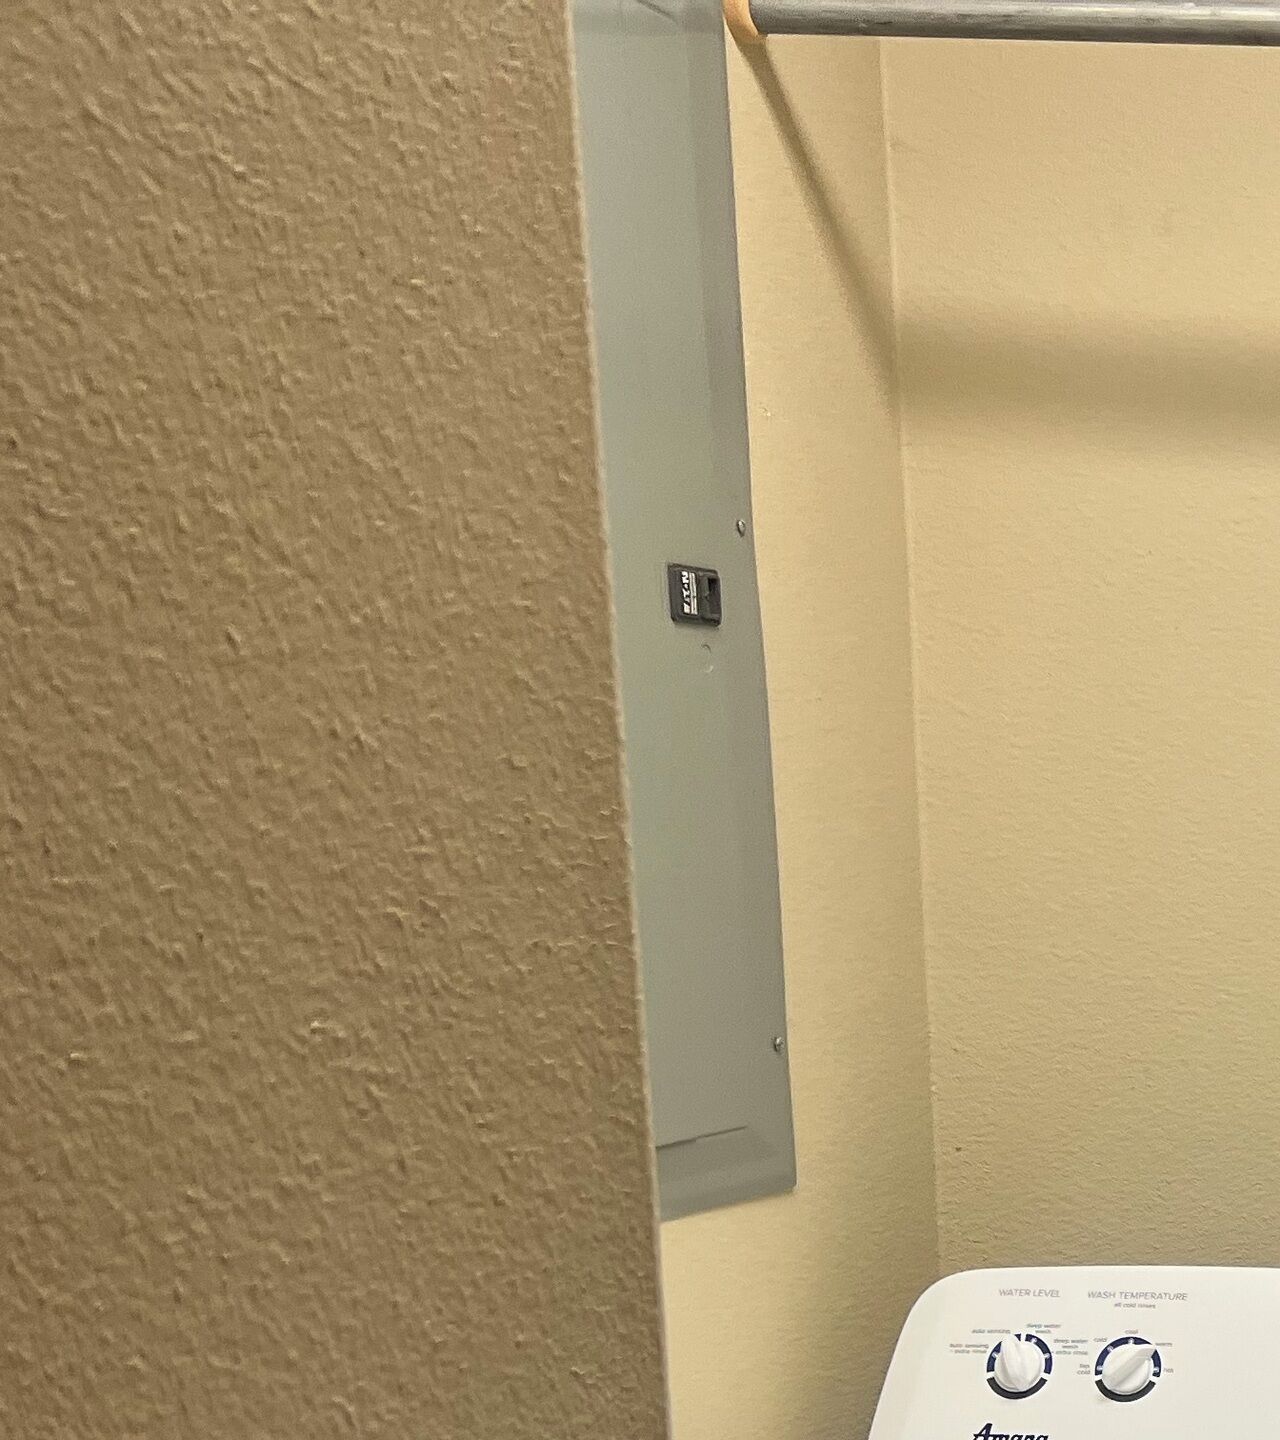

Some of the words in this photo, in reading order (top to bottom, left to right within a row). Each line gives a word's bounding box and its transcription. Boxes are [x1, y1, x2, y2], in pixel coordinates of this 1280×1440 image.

[999, 1289, 1031, 1297] WATER
[1033, 1290, 1061, 1298] LEVEL
[1088, 1291, 1116, 1299] WASH
[1119, 1291, 1188, 1301] TEMPERATURE
